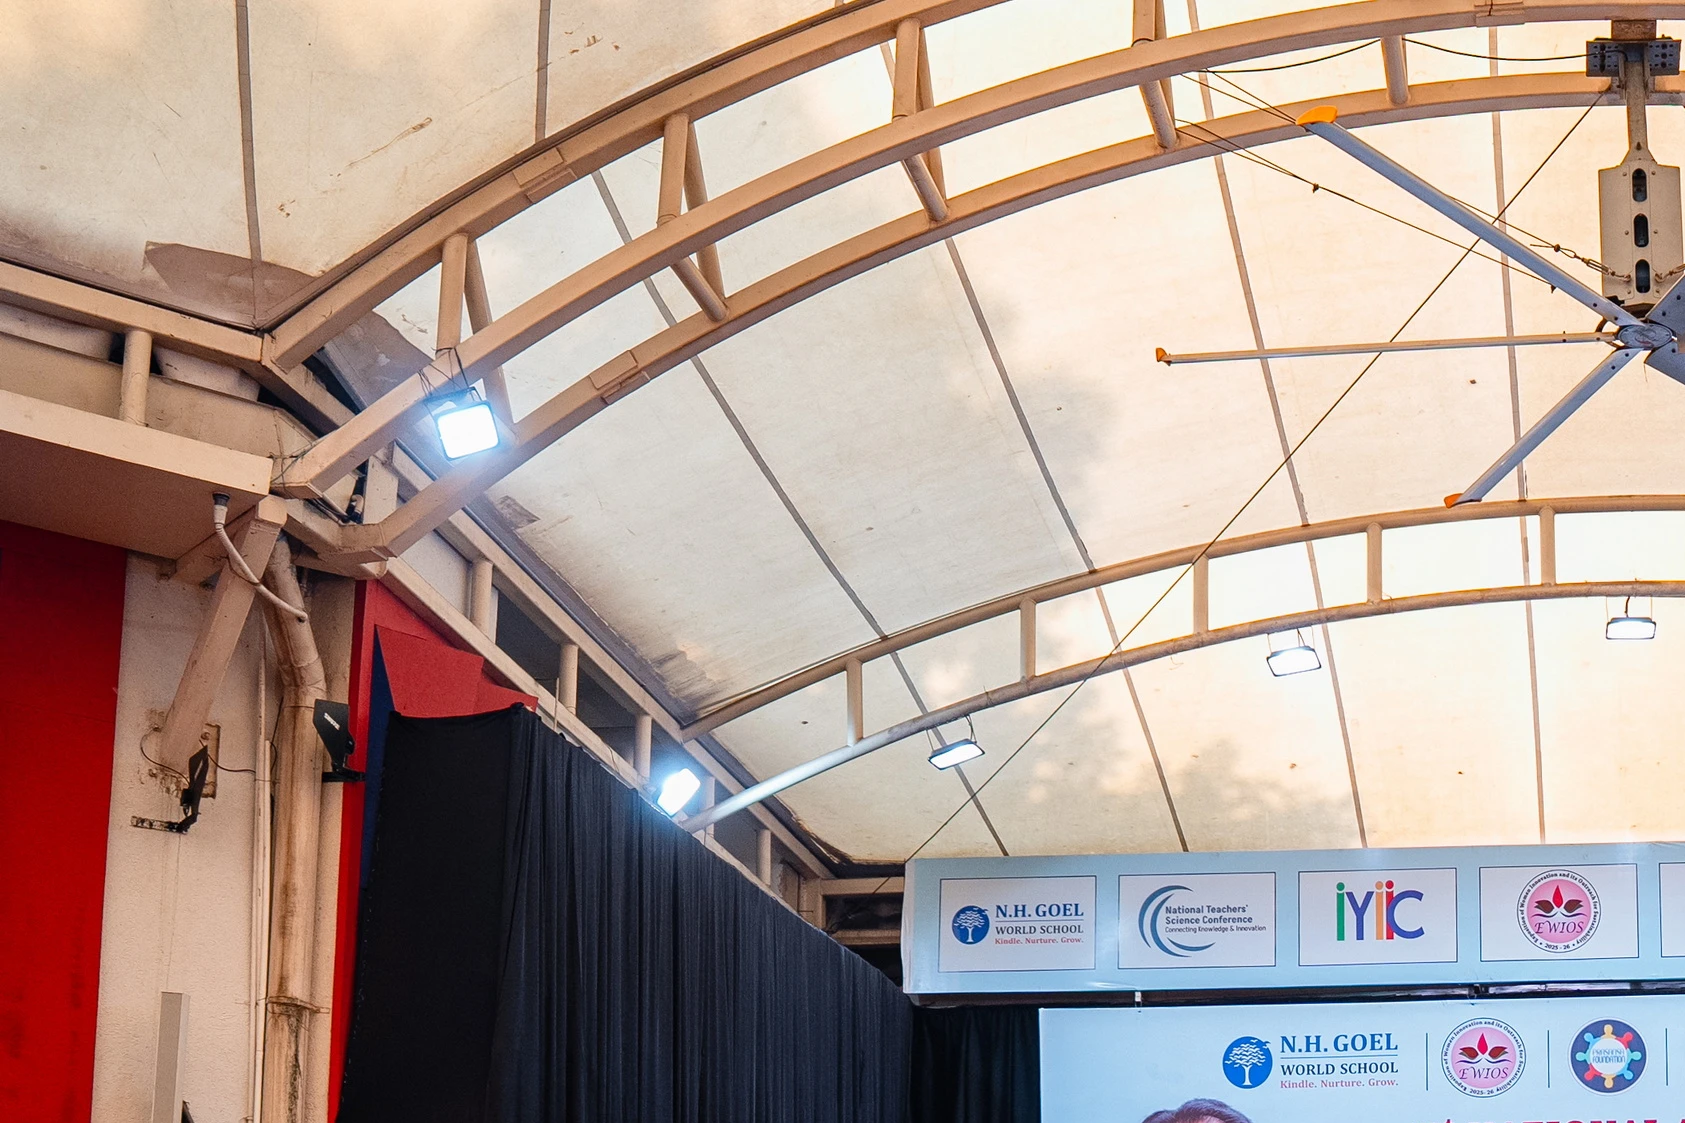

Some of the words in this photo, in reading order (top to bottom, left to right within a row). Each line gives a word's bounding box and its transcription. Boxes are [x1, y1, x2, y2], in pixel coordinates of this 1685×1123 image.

[996, 905, 1031, 917] N.H.
[1036, 904, 1083, 917] GOEL
[1165, 906, 1203, 914] National
[1166, 916, 1200, 924] Science
[1203, 916, 1252, 924] Conference
[996, 926, 1036, 934] WORLD
[1040, 925, 1083, 934] SCHOOL
[1535, 921, 1583, 933] EWIOS
